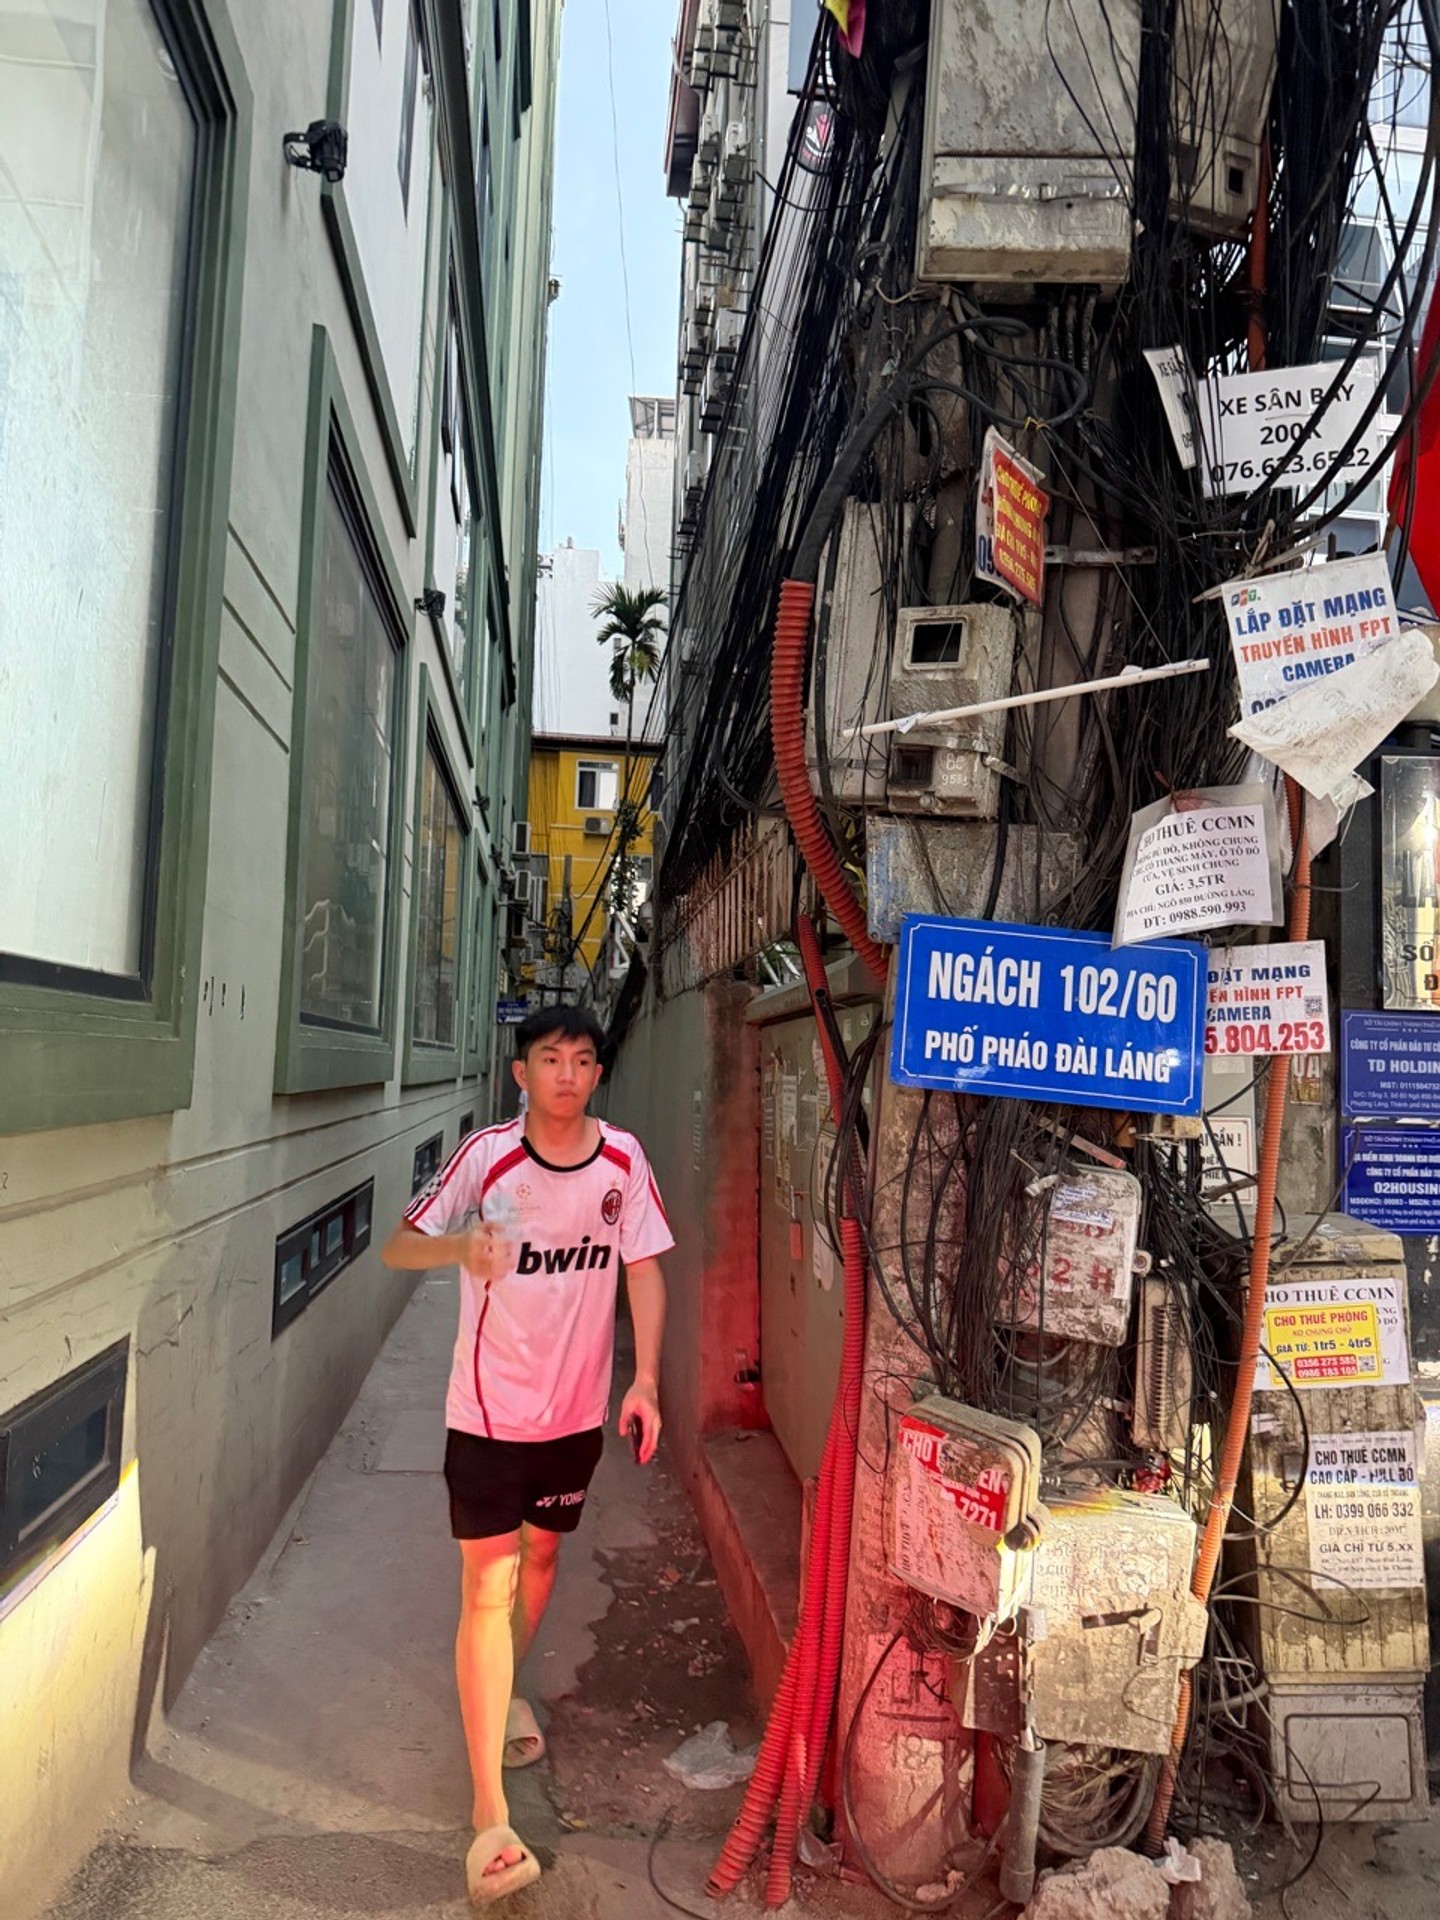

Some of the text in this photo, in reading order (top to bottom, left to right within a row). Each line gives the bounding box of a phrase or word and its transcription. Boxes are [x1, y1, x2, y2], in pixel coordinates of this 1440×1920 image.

[1219, 397, 1247, 417] XE
[1255, 387, 1302, 411] SÂN
[1235, 587, 1387, 636] LẮP ĐẶT MẠNG
[1240, 616, 1391, 664] TRUYỀN HÌNH FPT
[1282, 652, 1356, 683] CAMERA
[1155, 814, 1257, 842] THUÊ CCMN
[1182, 836, 1222, 852] KHÔNG
[1222, 835, 1259, 847] CHUNG
[1155, 854, 1190, 868] THANG
[1219, 846, 1229, 857] Ô
[1202, 858, 1240, 871] CHUNG
[1155, 879, 1184, 896] GIÁ:
[1169, 900, 1247, 925] 0988.590.993
[1251, 964, 1311, 982] MẠNG
[928, 945, 1177, 1024] NGÁCH 102/60
[1234, 985, 1270, 1002] HÌNH
[1276, 985, 1304, 999] FPT
[1206, 1005, 1272, 1023] CAMERA
[1204, 1021, 1325, 1054] 5.804.253
[924, 1024, 1171, 1084] PHỐ PHÁO ĐÀI LÁNG
[1367, 1059, 1386, 1073] TD
[516, 1235, 611, 1275] bwin
[1293, 1285, 1340, 1303] THUÊ
[1344, 1286, 1397, 1301] CCMN
[1274, 1315, 1297, 1328] CHO
[1300, 1311, 1327, 1325] THUÊ
[1330, 1308, 1368, 1323] PHÒNG
[1313, 1338, 1336, 1351] 1tr5
[1348, 1336, 1372, 1349] 4tr5
[903, 1430, 933, 1461] CHO
[1315, 1445, 1406, 1466] CHO THUÊ CCMN
[1310, 1470, 1333, 1485] CAO
[1314, 1505, 1333, 1519] LH:
[1336, 1504, 1365, 1519] 0399
[1392, 1502, 1414, 1517] 332
[1319, 1541, 1341, 1554] GIÁ
